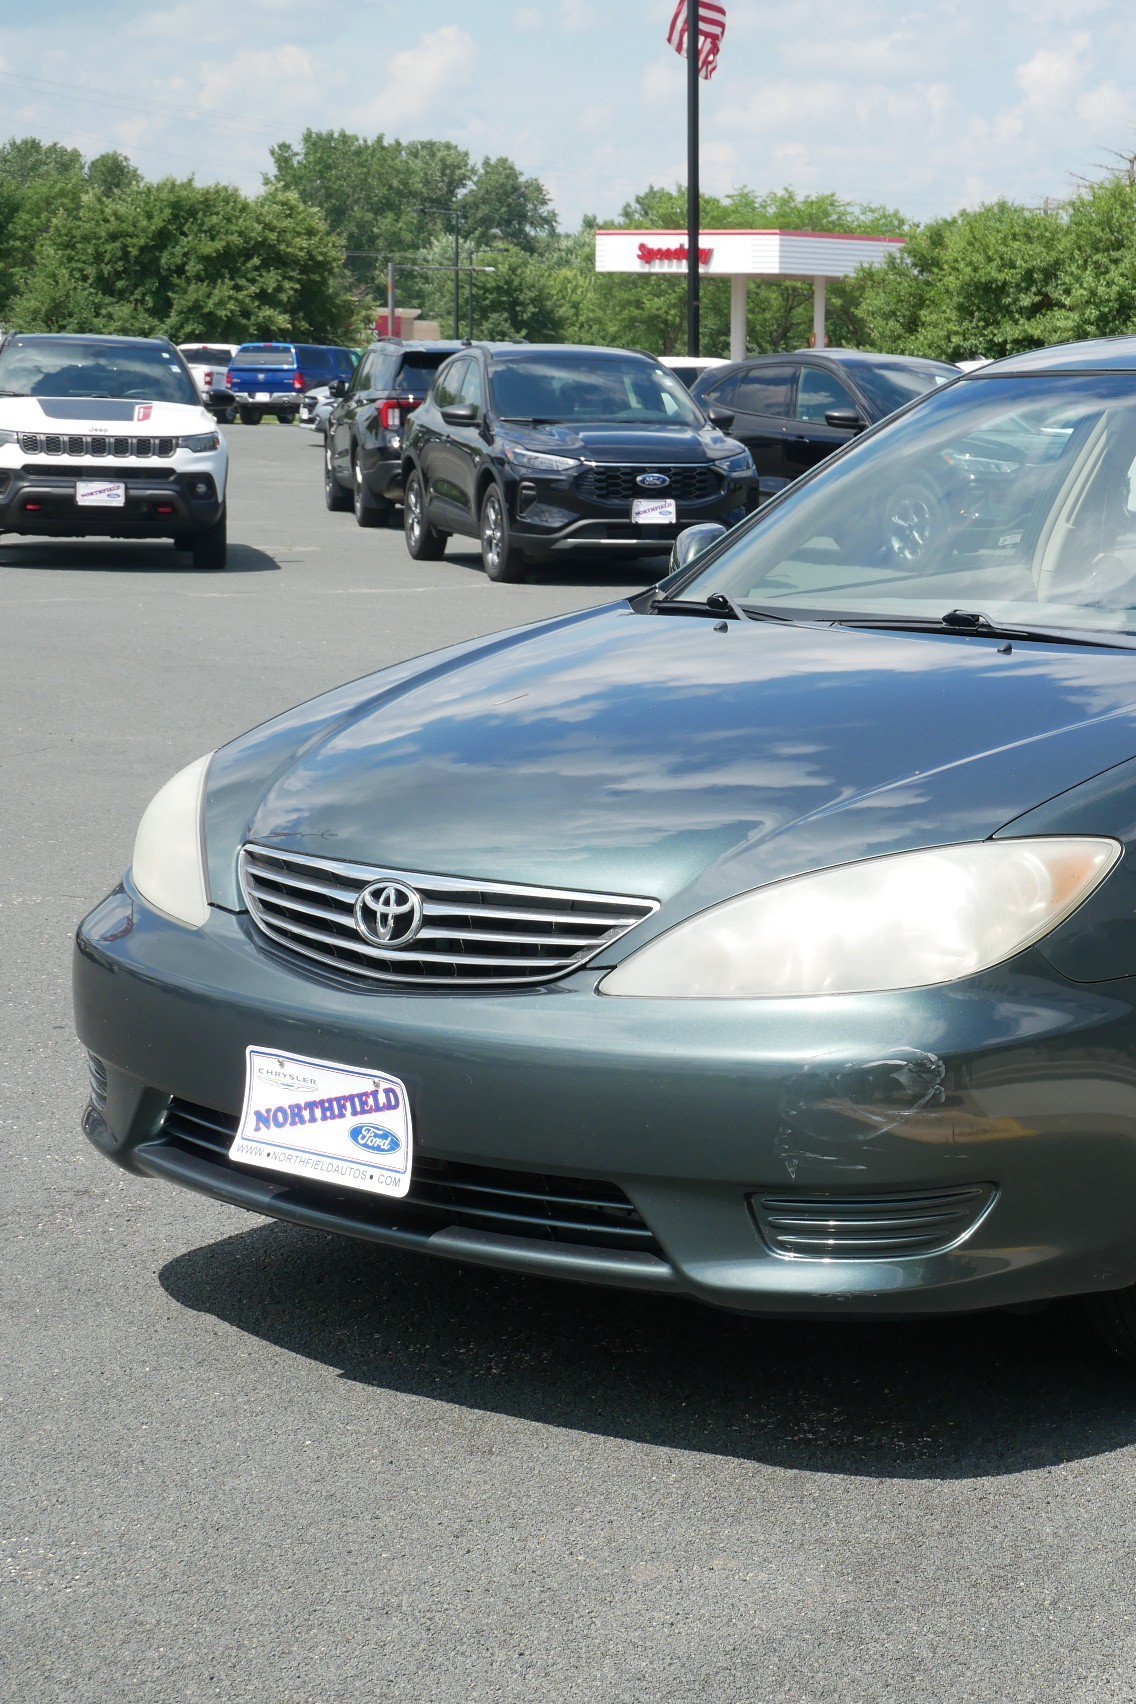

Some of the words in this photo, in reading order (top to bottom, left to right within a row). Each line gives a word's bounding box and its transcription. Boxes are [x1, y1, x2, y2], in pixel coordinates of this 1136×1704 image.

[637, 243, 713, 265] Speedy
[80, 485, 121, 498] NORTHFIELD
[635, 502, 672, 517] NORTHFIELD
[258, 1067, 317, 1086] CHRYSLER
[253, 1087, 400, 1132] NORTHFIELD
[357, 1125, 391, 1150] Ford
